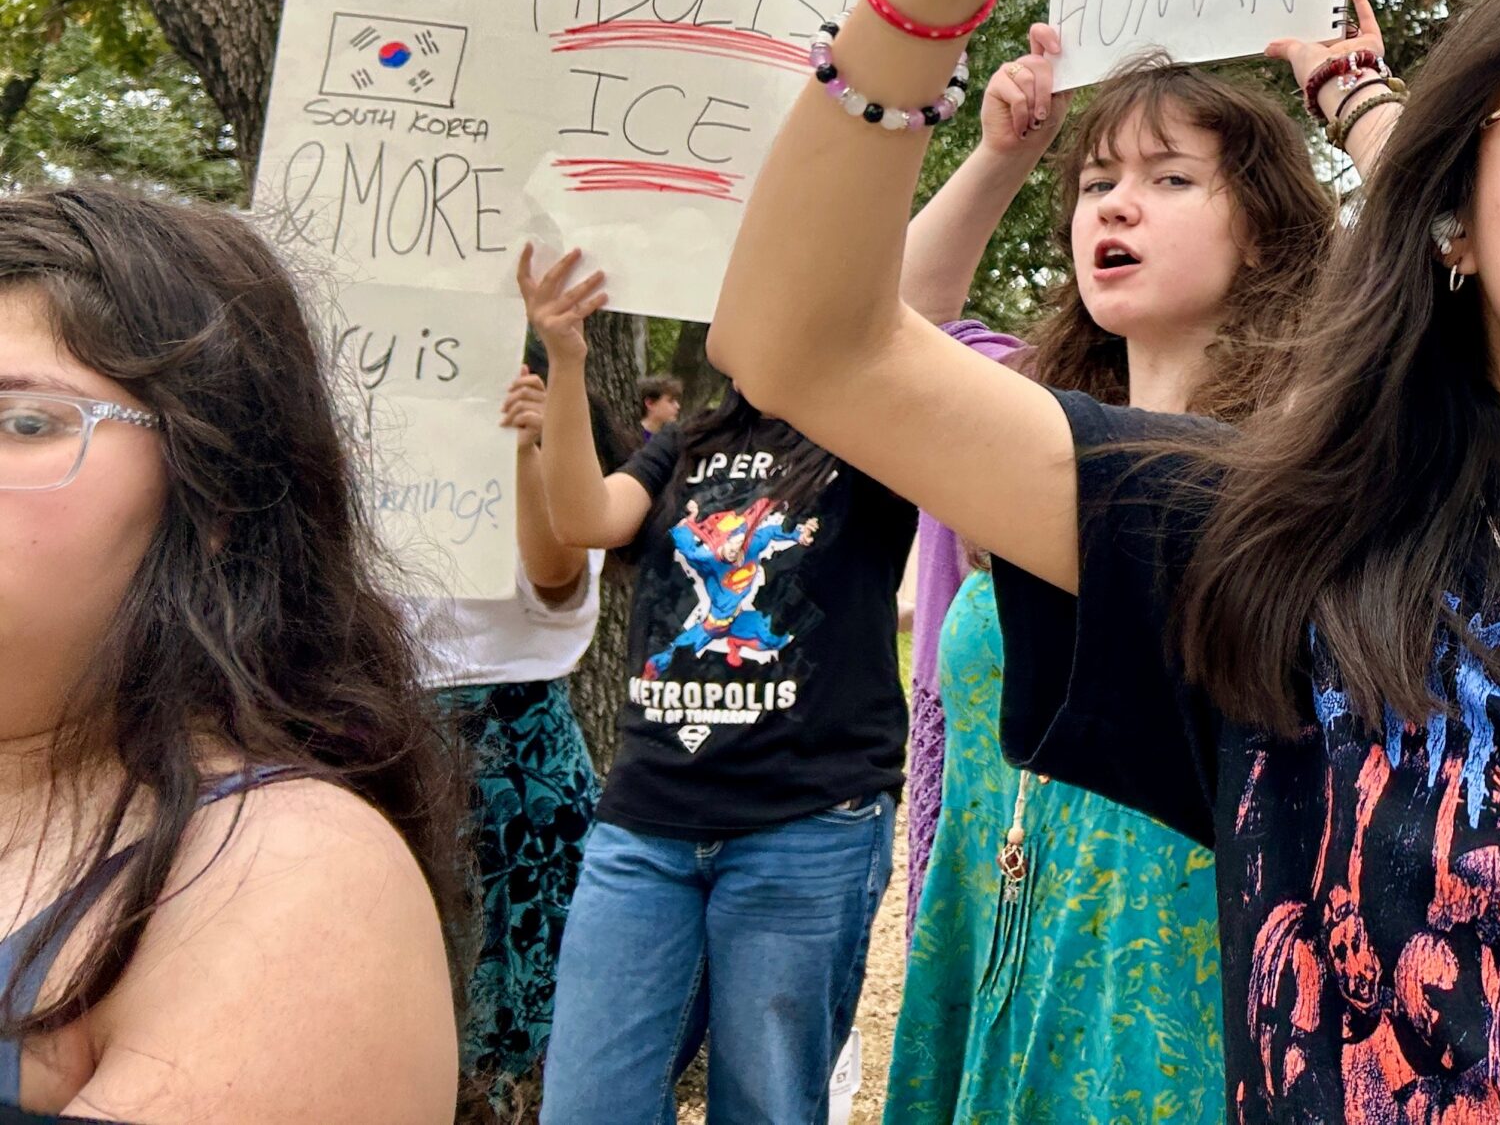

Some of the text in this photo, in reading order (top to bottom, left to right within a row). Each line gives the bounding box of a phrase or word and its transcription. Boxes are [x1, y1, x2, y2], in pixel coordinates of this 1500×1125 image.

[303, 98, 490, 143] SOUTH KOREA
[558, 68, 752, 164] ICE
[275, 140, 507, 260] & MORE
[415, 327, 460, 382] is
